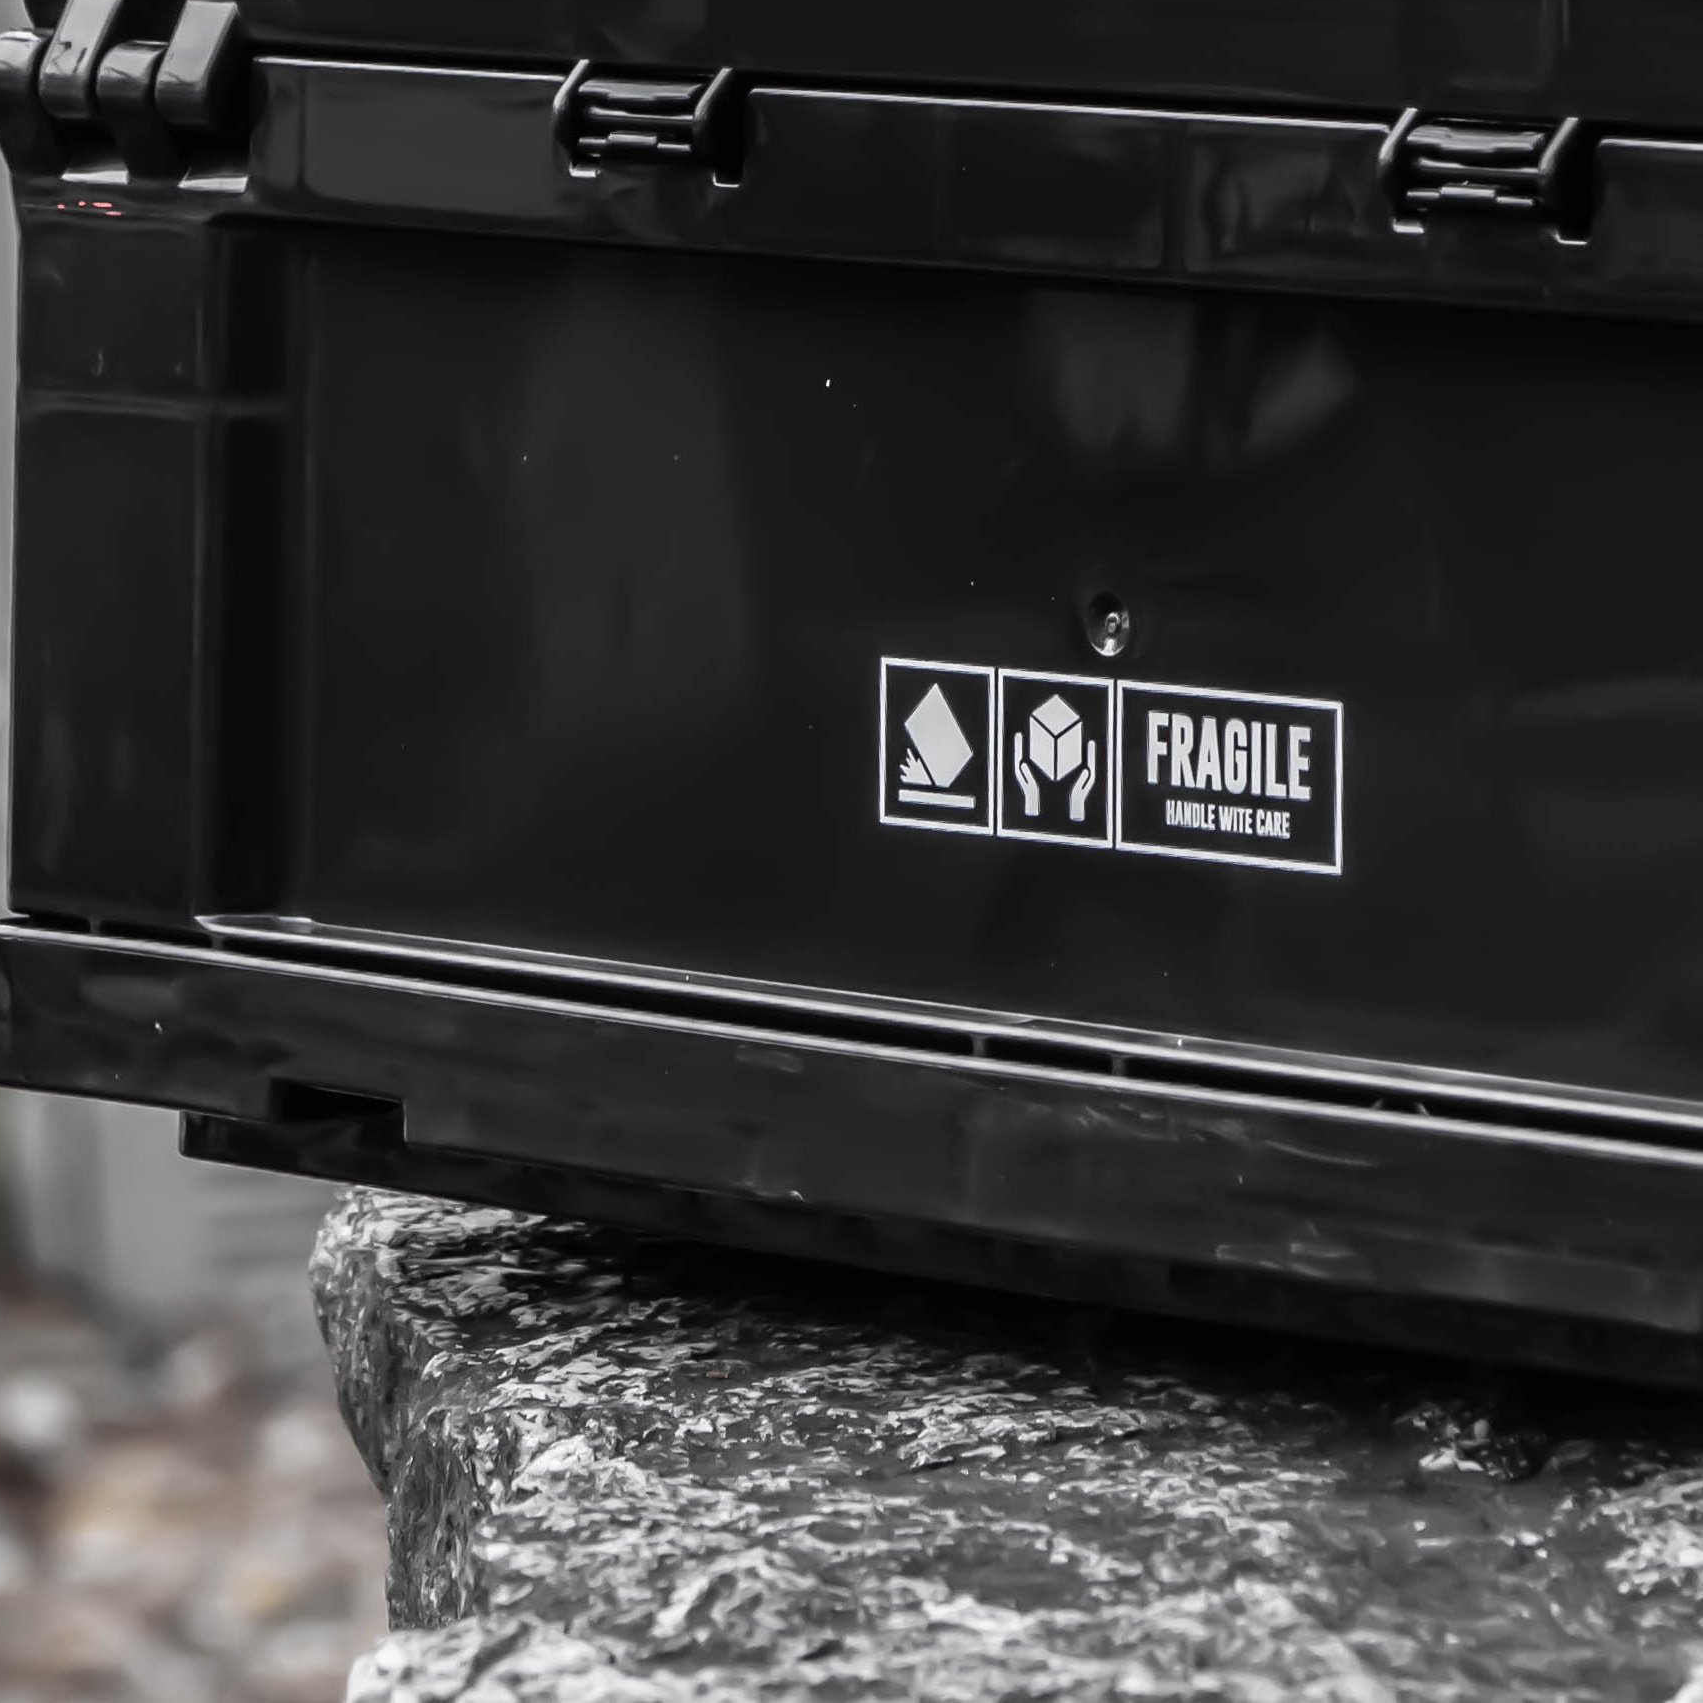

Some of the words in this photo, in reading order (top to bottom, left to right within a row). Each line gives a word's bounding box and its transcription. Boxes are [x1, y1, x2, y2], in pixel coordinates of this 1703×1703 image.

[1147, 710, 1311, 802] FRAGILE
[1165, 799, 1216, 830] HANDLE
[1256, 809, 1291, 839] CARE
